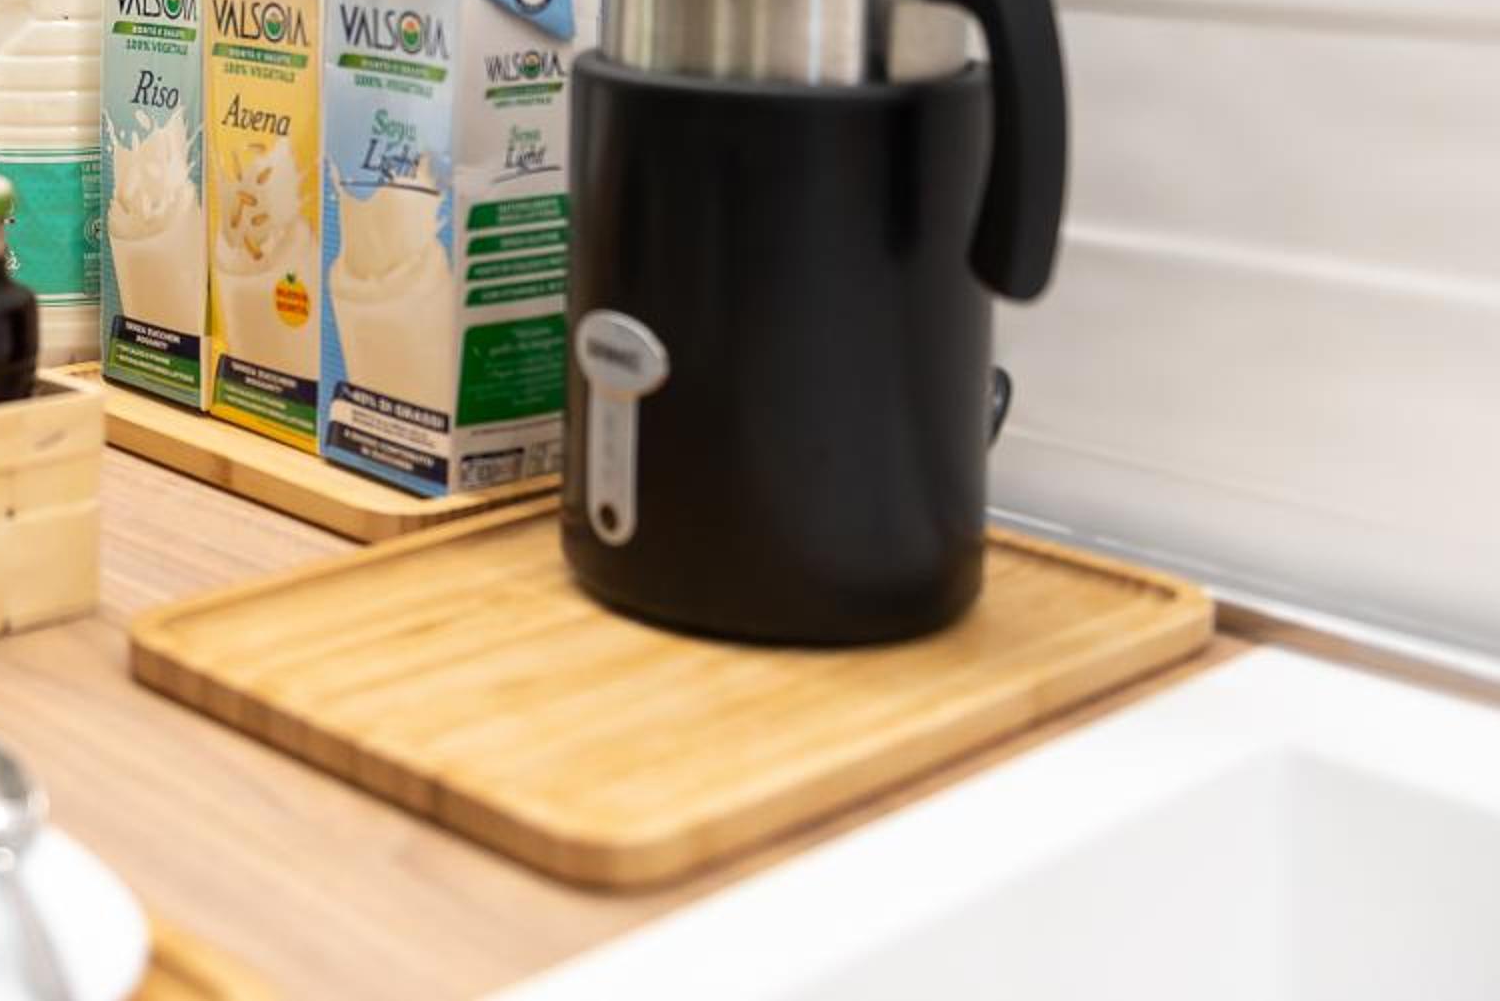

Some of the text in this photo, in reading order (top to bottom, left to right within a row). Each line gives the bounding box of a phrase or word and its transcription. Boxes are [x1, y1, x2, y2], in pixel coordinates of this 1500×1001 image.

[339, 2, 450, 61] VALSOIA
[484, 50, 567, 83] VALSOIA
[131, 69, 180, 110] Riso
[221, 93, 292, 136] Avena
[361, 138, 421, 184] Light
